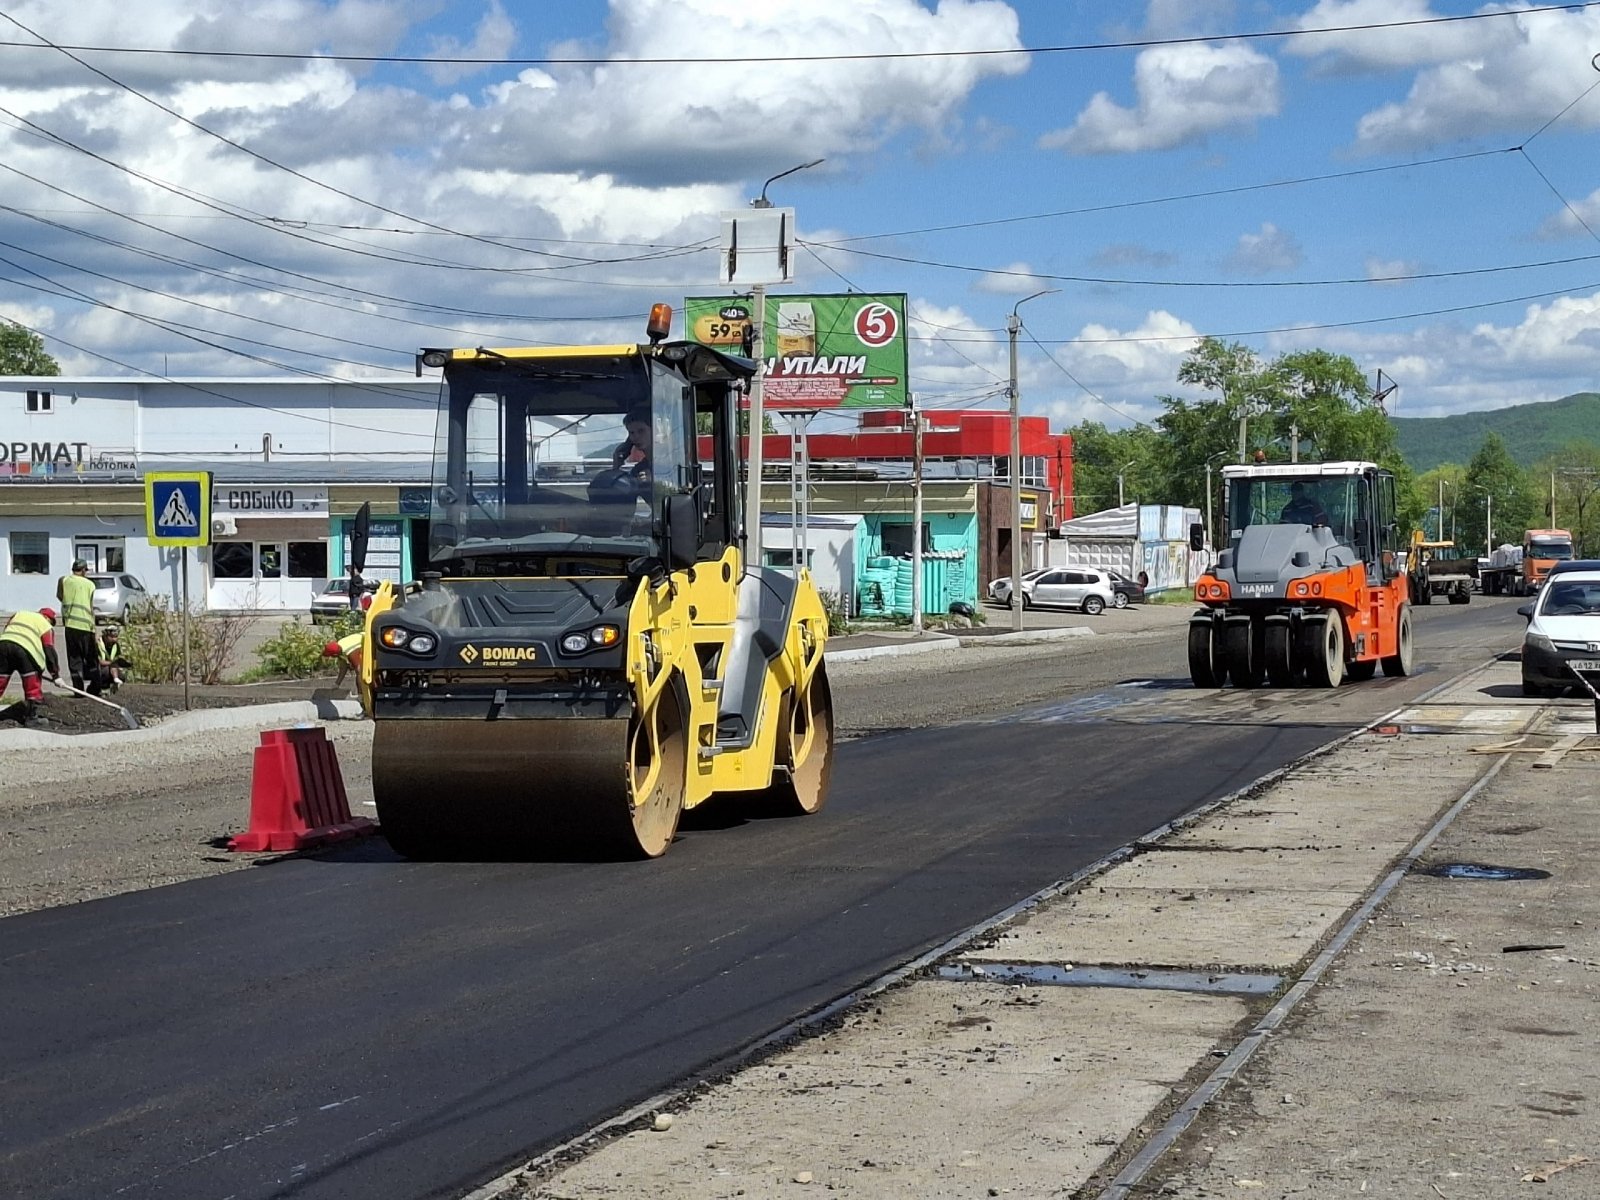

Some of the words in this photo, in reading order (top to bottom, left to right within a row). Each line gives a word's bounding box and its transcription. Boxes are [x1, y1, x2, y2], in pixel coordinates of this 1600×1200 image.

[710, 324, 730, 338] 59
[782, 356, 866, 375] УПАЛИ
[1241, 585, 1274, 594] HAMM
[482, 647, 536, 660] BOMAG
